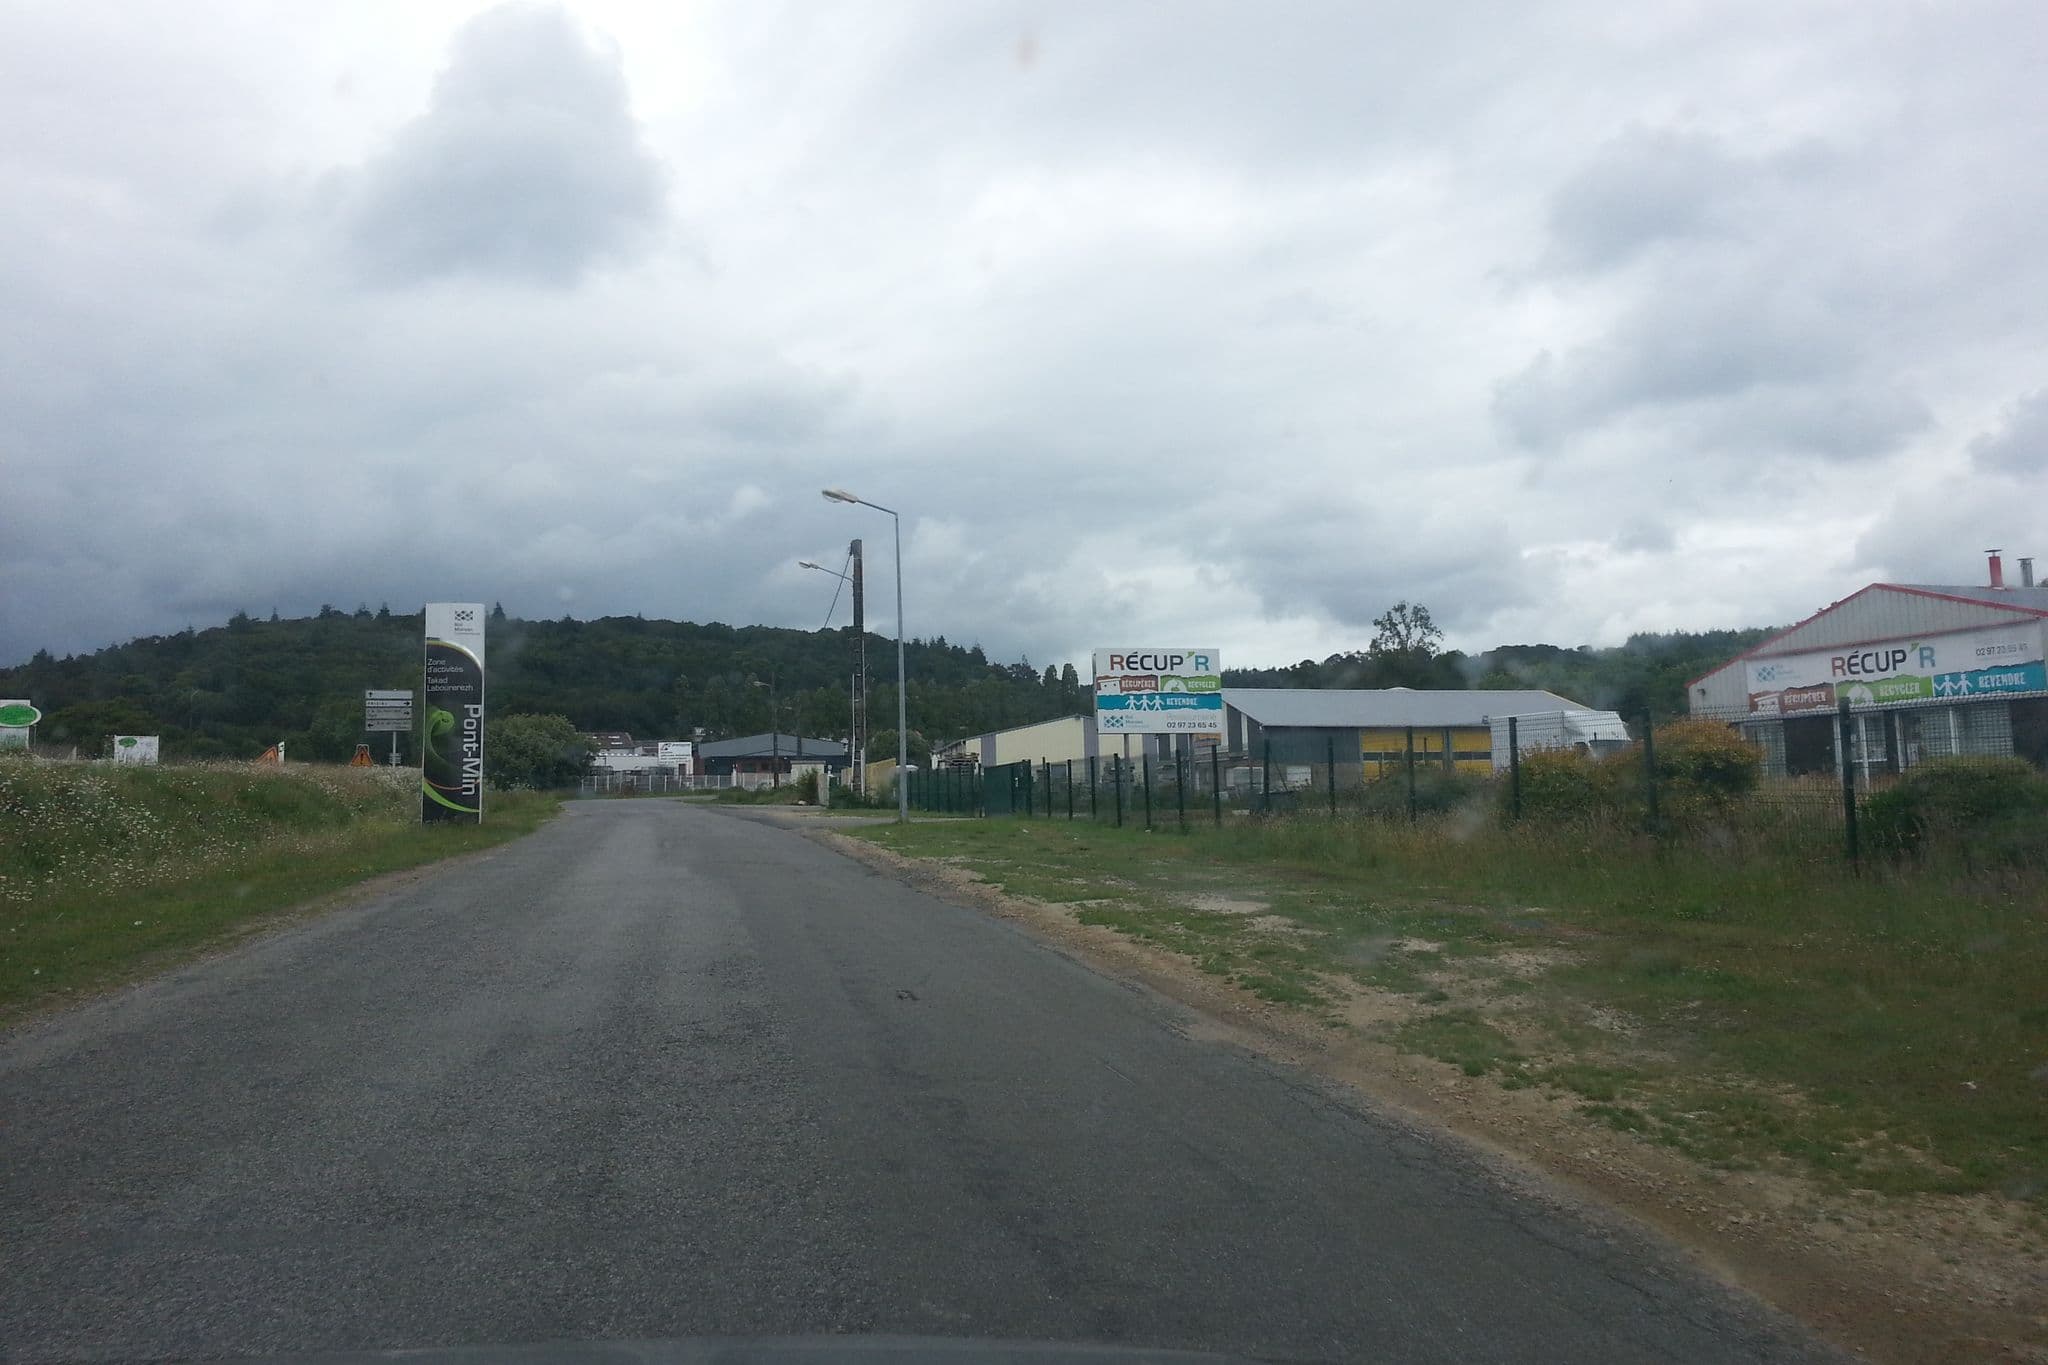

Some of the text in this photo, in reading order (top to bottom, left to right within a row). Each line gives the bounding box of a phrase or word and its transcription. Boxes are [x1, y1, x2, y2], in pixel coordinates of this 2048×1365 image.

[1976, 648, 1986, 656] 02
[1986, 647, 1995, 655] 97
[427, 658, 446, 666] Zone
[1110, 651, 1209, 671] RÉCUP'R
[1831, 642, 1936, 676] RÉCUP'R
[427, 665, 464, 673] d'activités
[1978, 671, 2026, 689] REVENDRE
[1166, 721, 1176, 729] 02
[462, 704, 482, 796] Pont-Min
